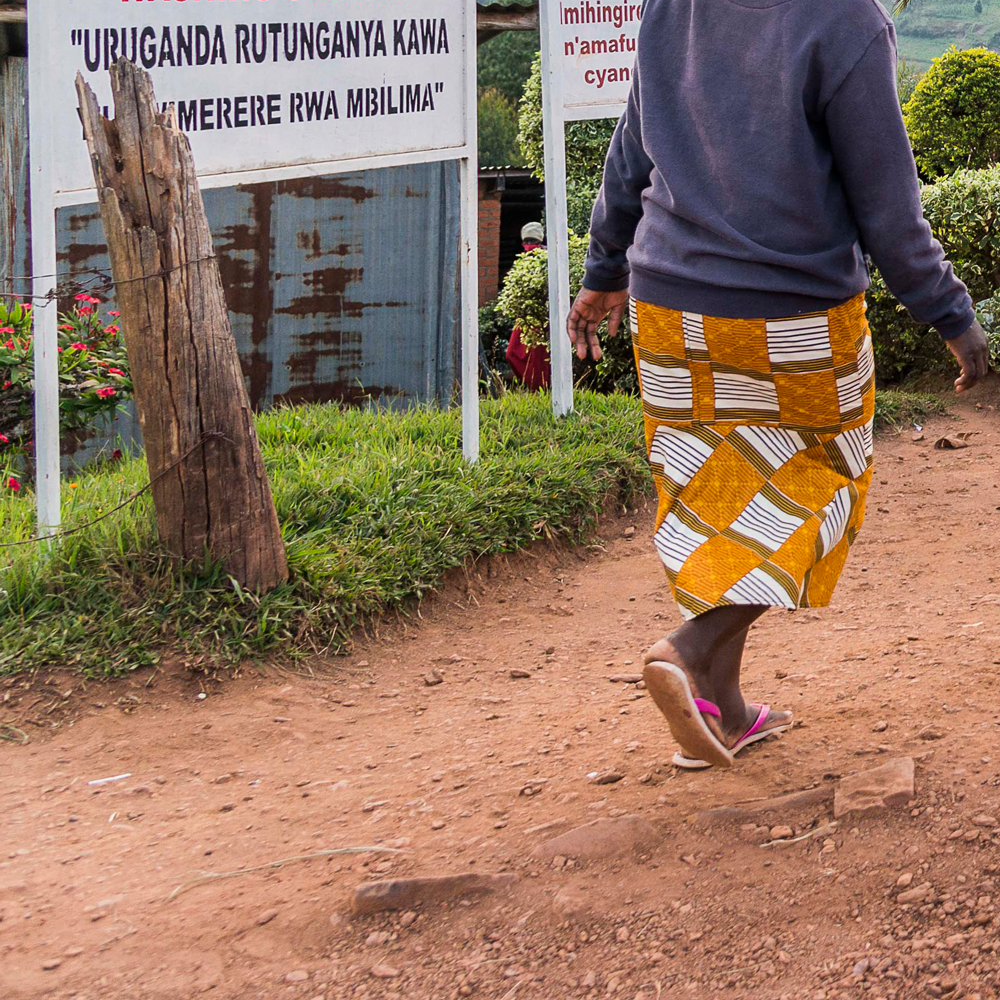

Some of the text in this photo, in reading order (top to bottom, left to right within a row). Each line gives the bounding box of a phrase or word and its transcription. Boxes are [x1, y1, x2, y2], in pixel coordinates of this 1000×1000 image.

[235, 20, 387, 64] RUTUNGANYA
[393, 18, 449, 56] KAWA
[584, 67, 634, 89] cyan
[290, 90, 339, 123] RWA
[346, 82, 444, 119] MBILIMA"
